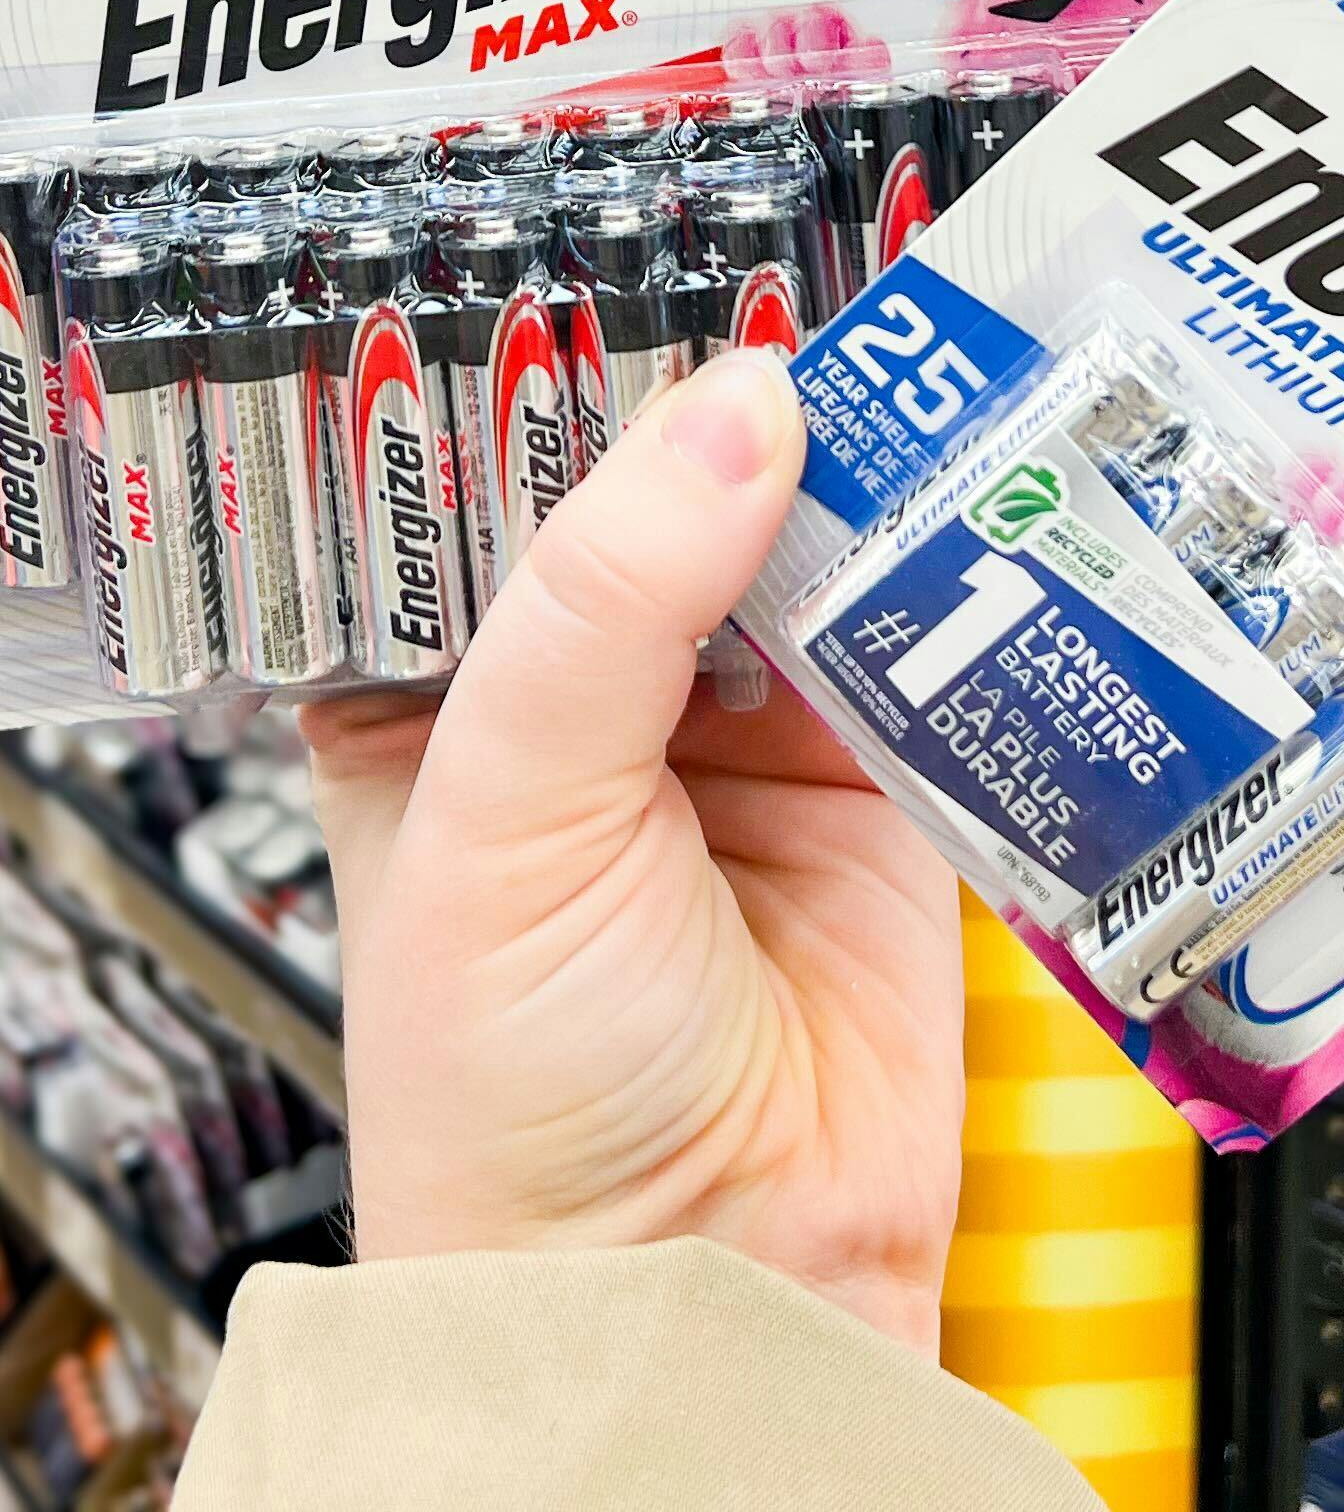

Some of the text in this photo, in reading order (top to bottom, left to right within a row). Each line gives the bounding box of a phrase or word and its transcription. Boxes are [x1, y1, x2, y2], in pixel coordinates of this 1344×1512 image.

[42, 358, 68, 436] MAX
[817, 348, 926, 463] YEAR SHELF
[837, 292, 990, 436] 25
[436, 433, 457, 511] MAX
[797, 366, 907, 481] LIFE/ANS DE
[829, 436, 861, 469] DE
[853, 459, 889, 497] VIE
[123, 461, 154, 544] MAX
[217, 451, 242, 535] MAX
[378, 415, 444, 652] Energizer
[1059, 515, 1128, 569] INCLUDES
[1046, 526, 1116, 581] RECYCLED
[1132, 570, 1215, 633] COMPREND
[969, 669, 1062, 770] LA PILE
[995, 645, 1110, 764] BATTERY
[1013, 624, 1162, 786] LASTING
[1036, 604, 1188, 761] LONGEST
[925, 702, 1078, 867] DURABLE
[947, 682, 1080, 827] LA PLUS
[1096, 749, 1284, 951] Energizer
[1212, 807, 1319, 907] ULTIMATE
